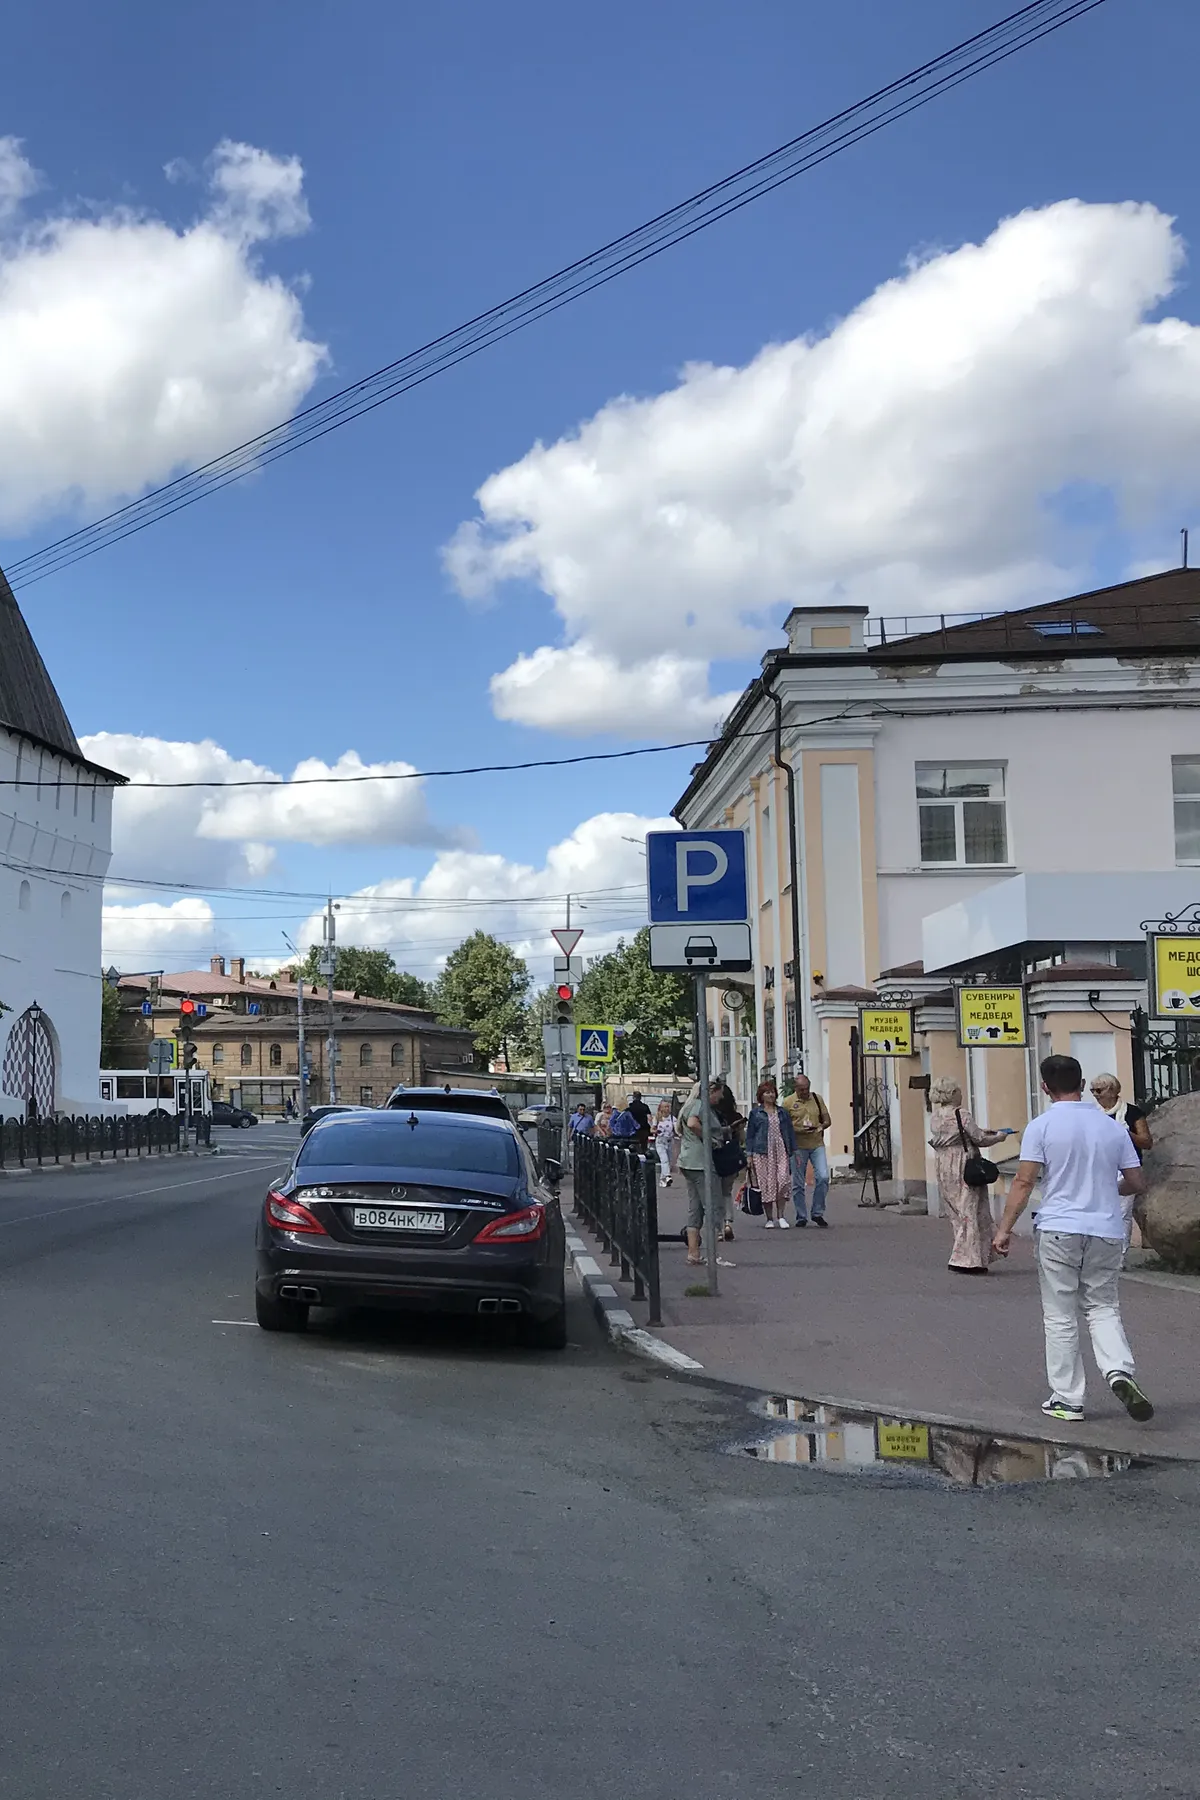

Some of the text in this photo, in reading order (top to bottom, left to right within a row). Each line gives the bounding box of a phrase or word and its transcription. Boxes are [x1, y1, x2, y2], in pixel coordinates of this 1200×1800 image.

[676, 840, 728, 911] P
[965, 993, 1016, 1001] СУВЕНИРЫ
[984, 1002, 997, 1010] ОТ
[874, 1016, 899, 1024] МУЗЕЙ
[969, 1012, 1013, 1020] МЕДВЕДЯ
[869, 1025, 904, 1033] МЕДВЕДЯ
[359, 1210, 441, 1227] В084НК 777
